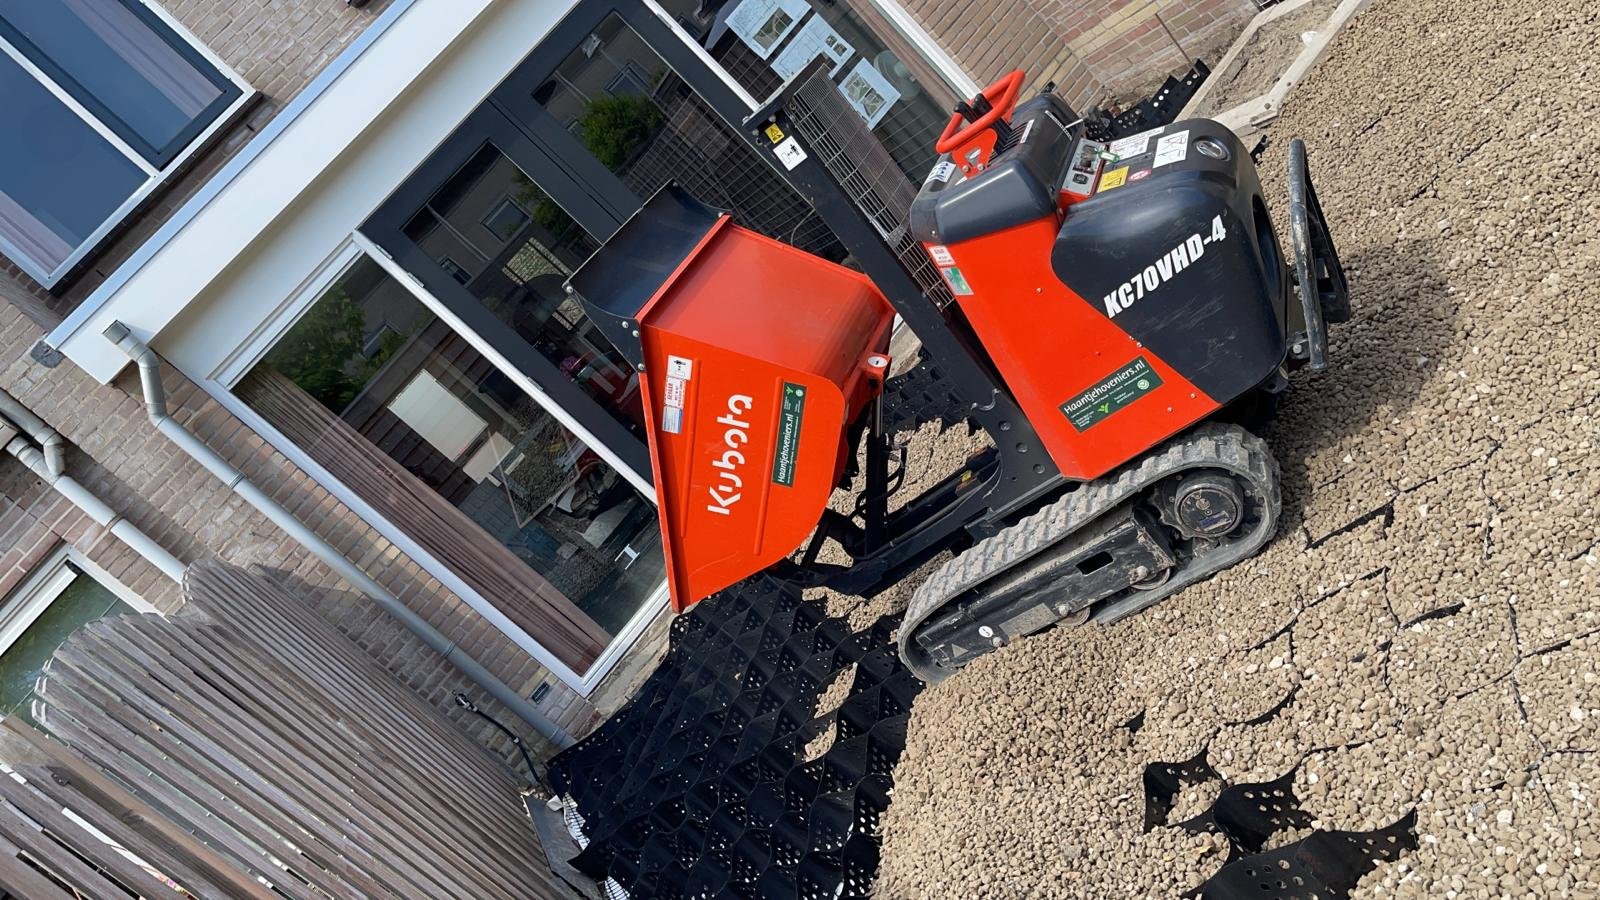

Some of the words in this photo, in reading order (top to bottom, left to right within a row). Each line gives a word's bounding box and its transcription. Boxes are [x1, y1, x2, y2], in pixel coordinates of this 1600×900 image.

[1104, 214, 1227, 319] KC70VHD-4
[1063, 359, 1146, 414] Haantjehoveniers.nl
[707, 394, 753, 516] Kubota
[777, 413, 794, 483] Haantjehoveniers.nl
